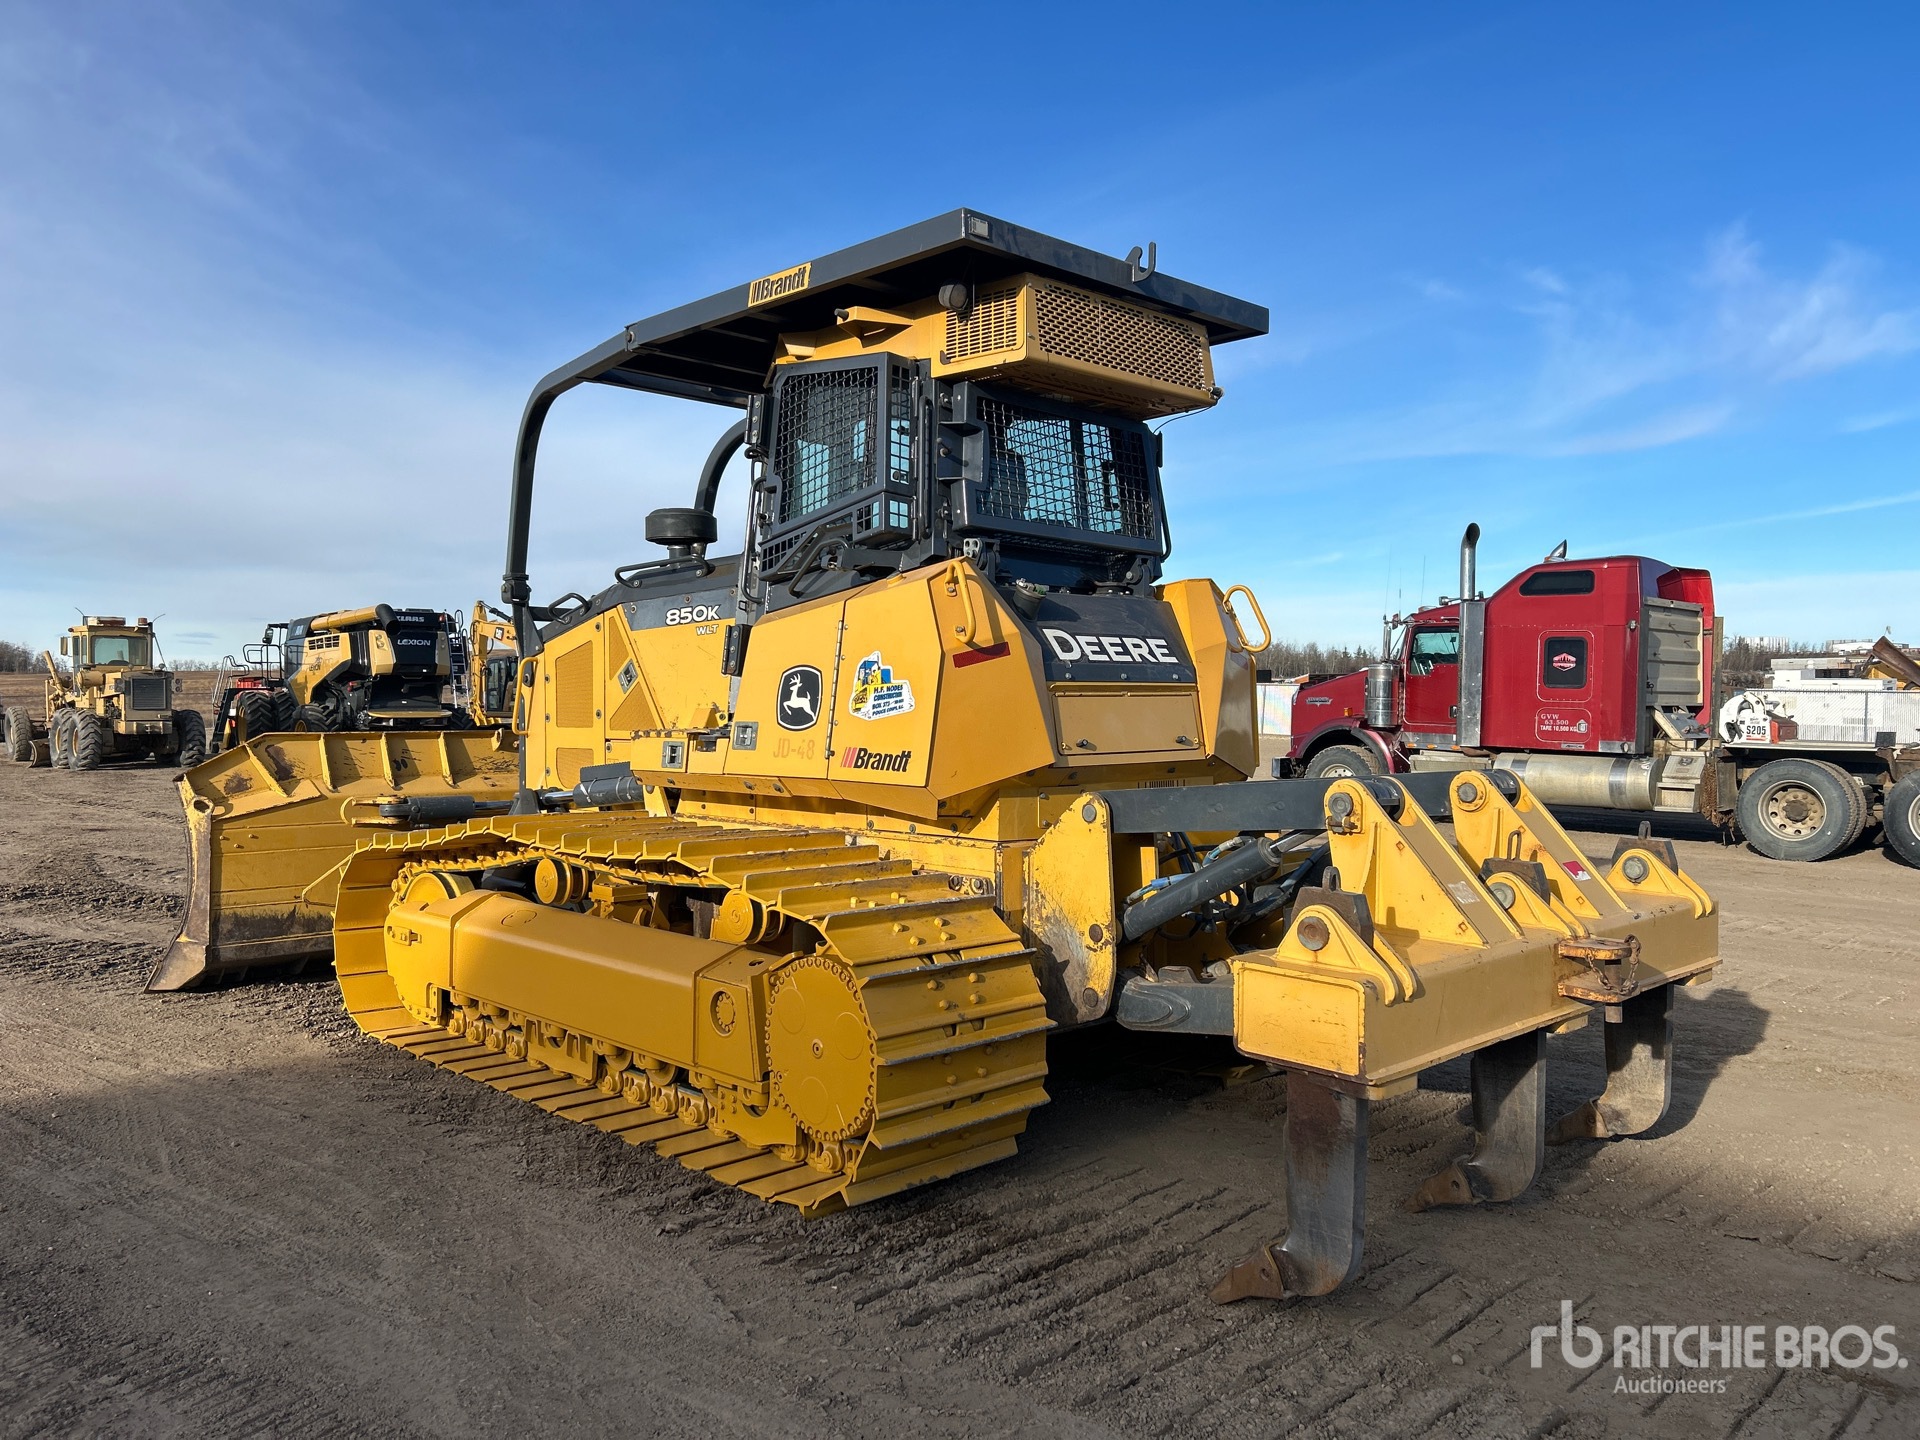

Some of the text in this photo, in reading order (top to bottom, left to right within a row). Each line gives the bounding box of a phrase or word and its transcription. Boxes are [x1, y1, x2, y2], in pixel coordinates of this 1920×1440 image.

[760, 266, 807, 300] Brandt
[665, 604, 720, 626] 850K
[696, 624, 719, 635] WLT
[397, 638, 431, 646] LEXION
[1042, 628, 1179, 663] DEERE
[1746, 725, 1766, 735] S205
[773, 737, 815, 760] JD-48
[853, 747, 912, 772] Brandt
